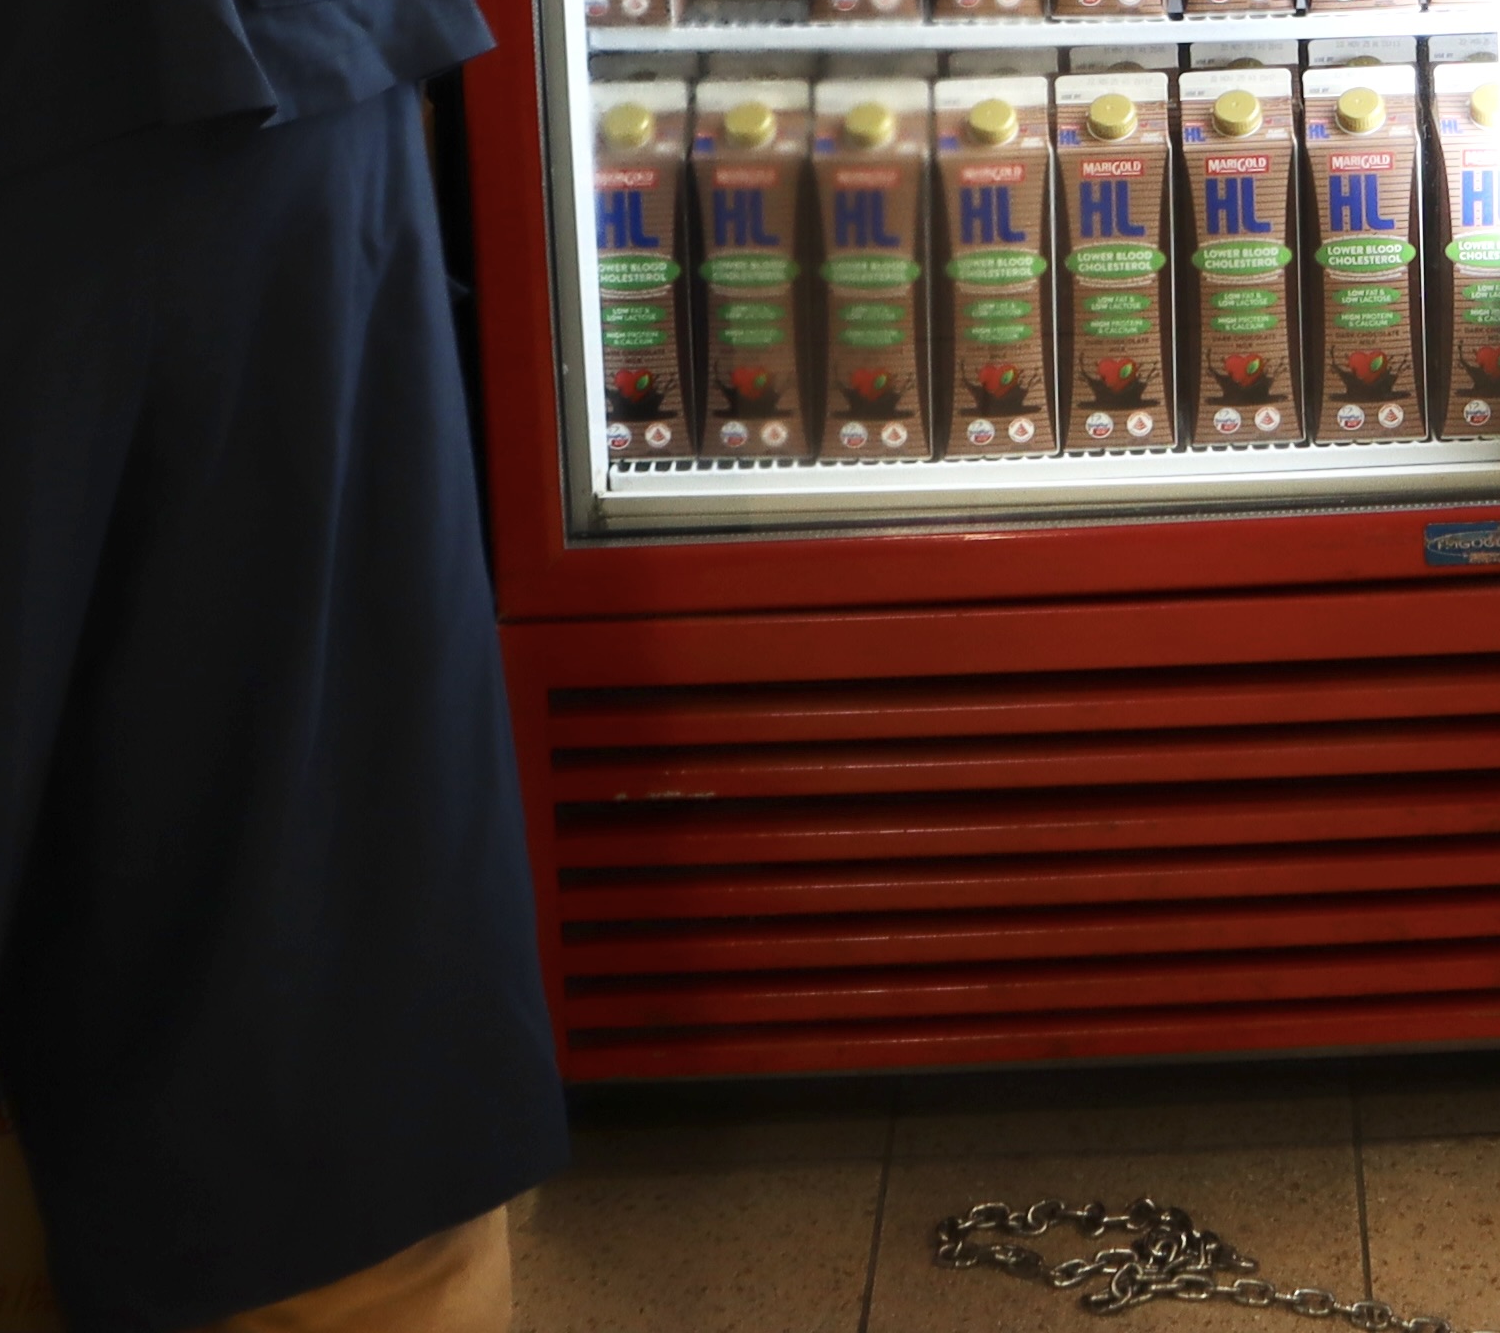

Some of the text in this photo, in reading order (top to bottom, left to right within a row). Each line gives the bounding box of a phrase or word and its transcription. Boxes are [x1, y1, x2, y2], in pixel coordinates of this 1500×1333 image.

[1208, 156, 1267, 173] MARIGOLD
[1331, 154, 1391, 170] MARIGOLD
[1082, 182, 1144, 235] HL
[1207, 177, 1271, 233] HL
[1330, 174, 1395, 231] HL
[1327, 245, 1402, 256] LOWER BLOOD
[1328, 255, 1402, 266] CHOLESTEROL
